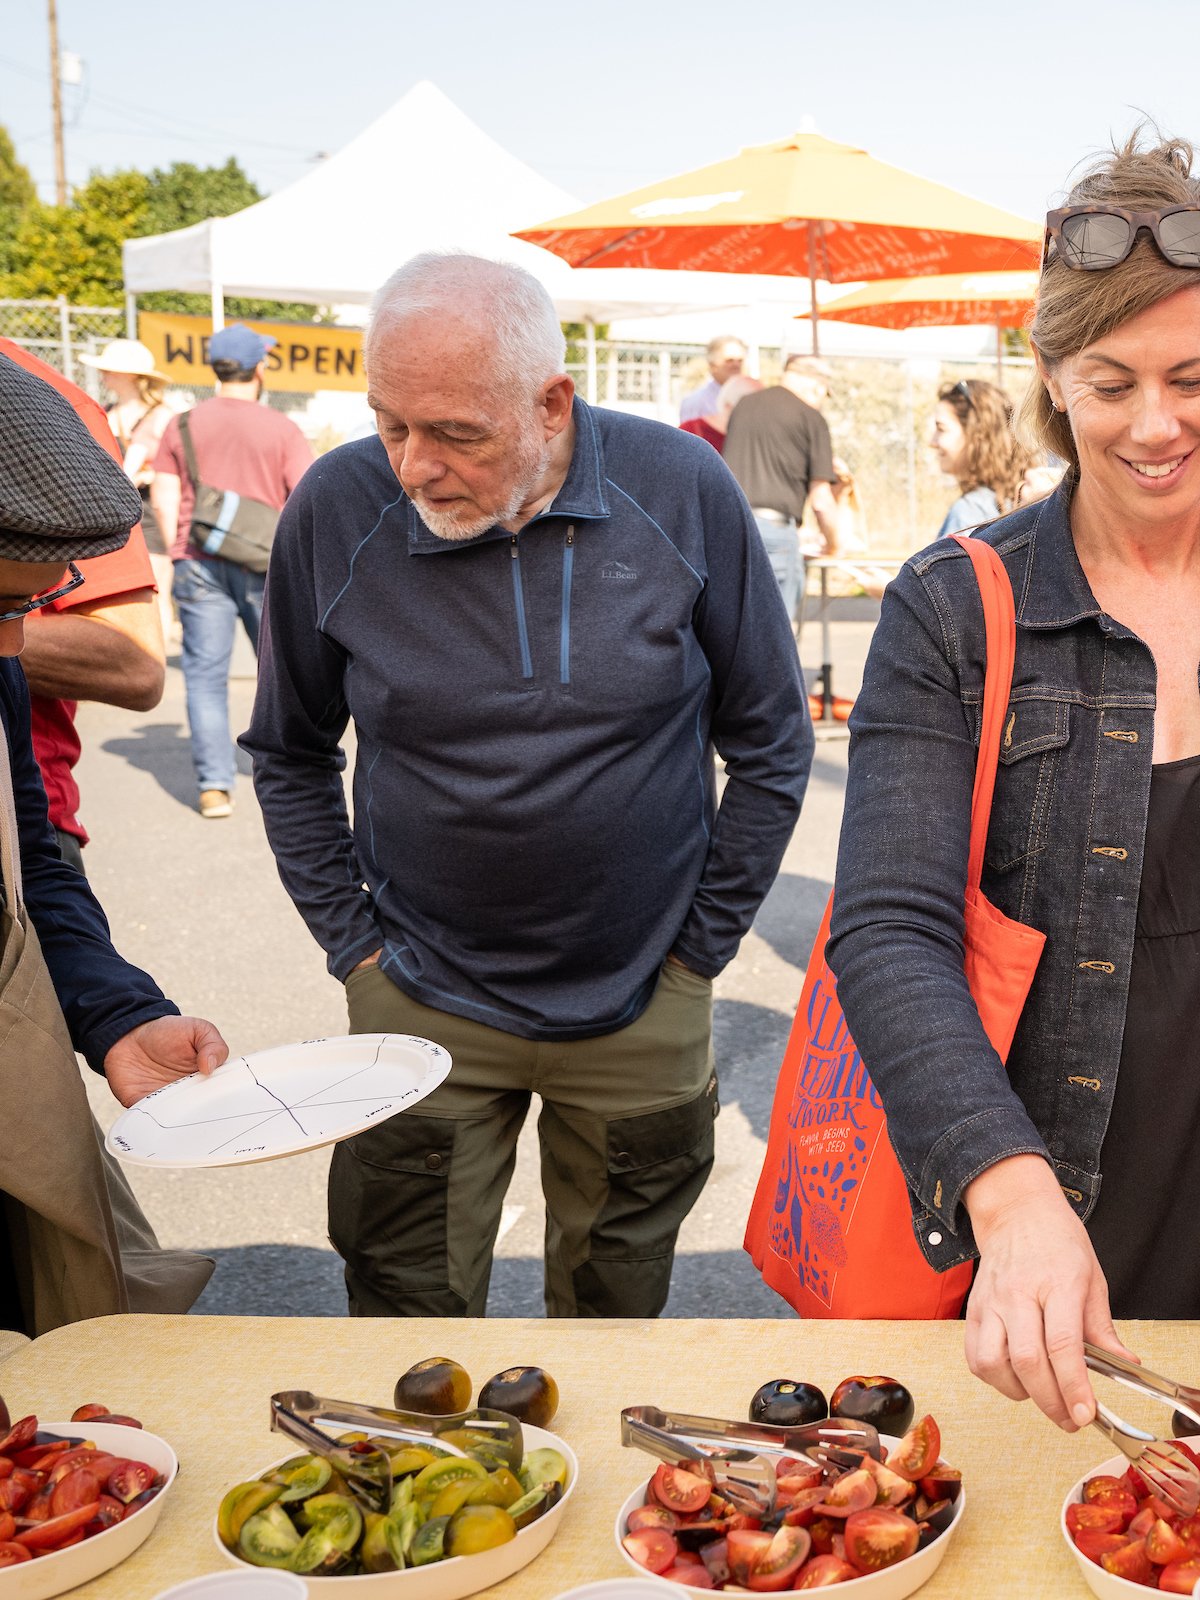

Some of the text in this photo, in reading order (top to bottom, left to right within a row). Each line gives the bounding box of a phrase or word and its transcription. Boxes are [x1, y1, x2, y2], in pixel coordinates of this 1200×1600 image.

[267, 340, 367, 377] SPEN
[822, 1127, 850, 1141] BEGINS
[825, 1140, 846, 1153] SEED
